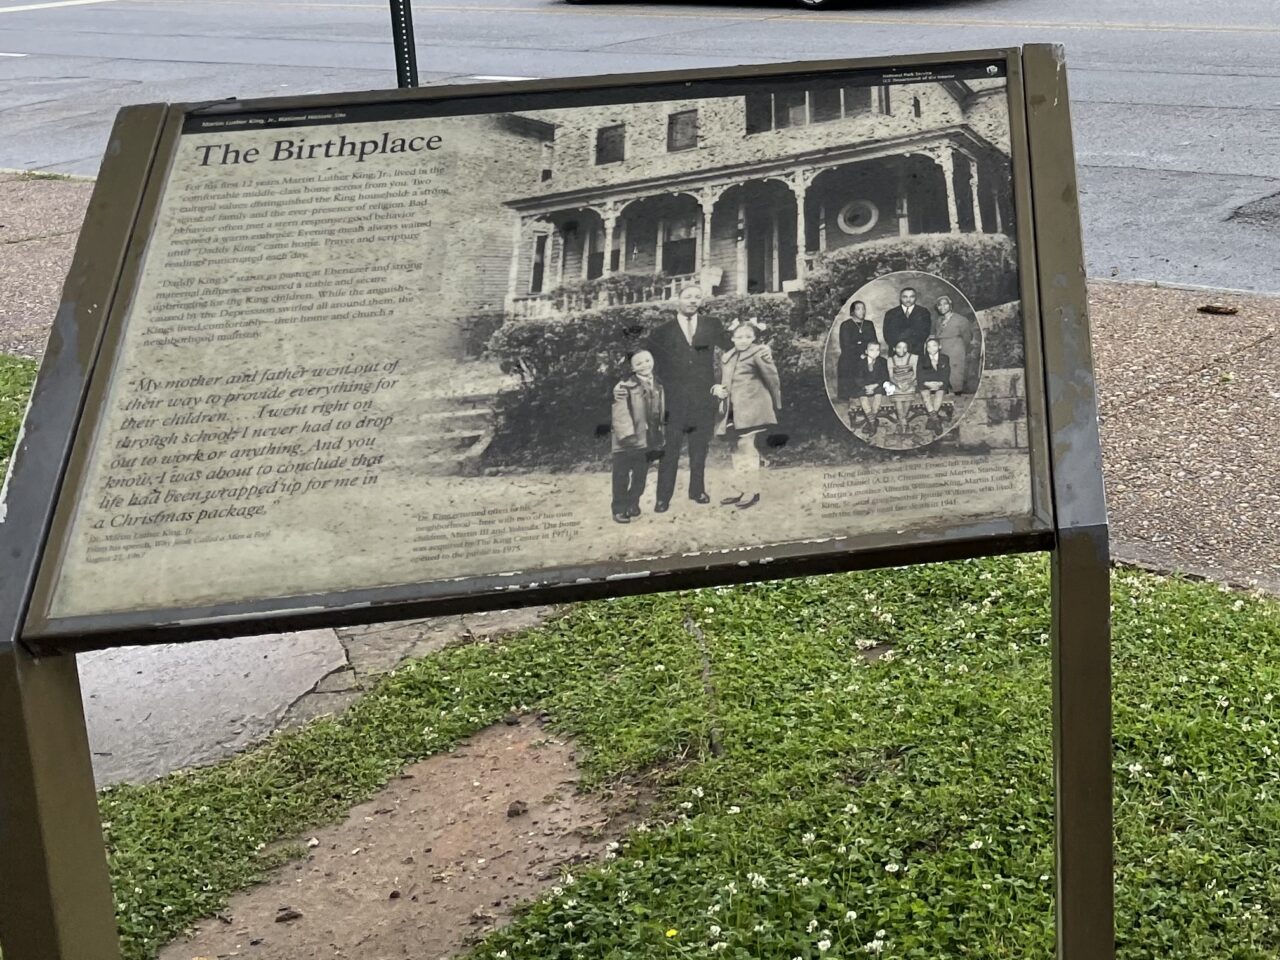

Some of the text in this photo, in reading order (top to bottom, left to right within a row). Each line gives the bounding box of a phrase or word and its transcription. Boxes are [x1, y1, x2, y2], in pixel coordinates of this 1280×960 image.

[195, 132, 442, 167] The Birthplace
[165, 375, 222, 388] mother
[226, 371, 257, 383] and
[260, 368, 308, 384] father
[312, 364, 349, 376] went
[352, 362, 379, 373] out
[383, 359, 399, 374] of
[126, 378, 400, 410] their way to provide everything for
[121, 417, 159, 429] their
[257, 407, 269, 418] I
[270, 404, 307, 417] went
[312, 400, 349, 416] right
[353, 401, 373, 410] on
[116, 433, 178, 448] through
[242, 427, 250, 437] I
[253, 426, 297, 437] never
[301, 420, 334, 432] had
[336, 420, 351, 430] to
[356, 417, 393, 431] drop
[111, 438, 375, 469] out to work or anything. And you
[159, 472, 167, 483] I
[170, 473, 202, 482] was
[206, 466, 253, 479] about
[257, 465, 272, 474] to
[277, 457, 347, 472] conclude
[352, 454, 384, 466] that
[99, 475, 378, 511] life had been wrapped up for me in
[111, 513, 194, 527] Christmas
